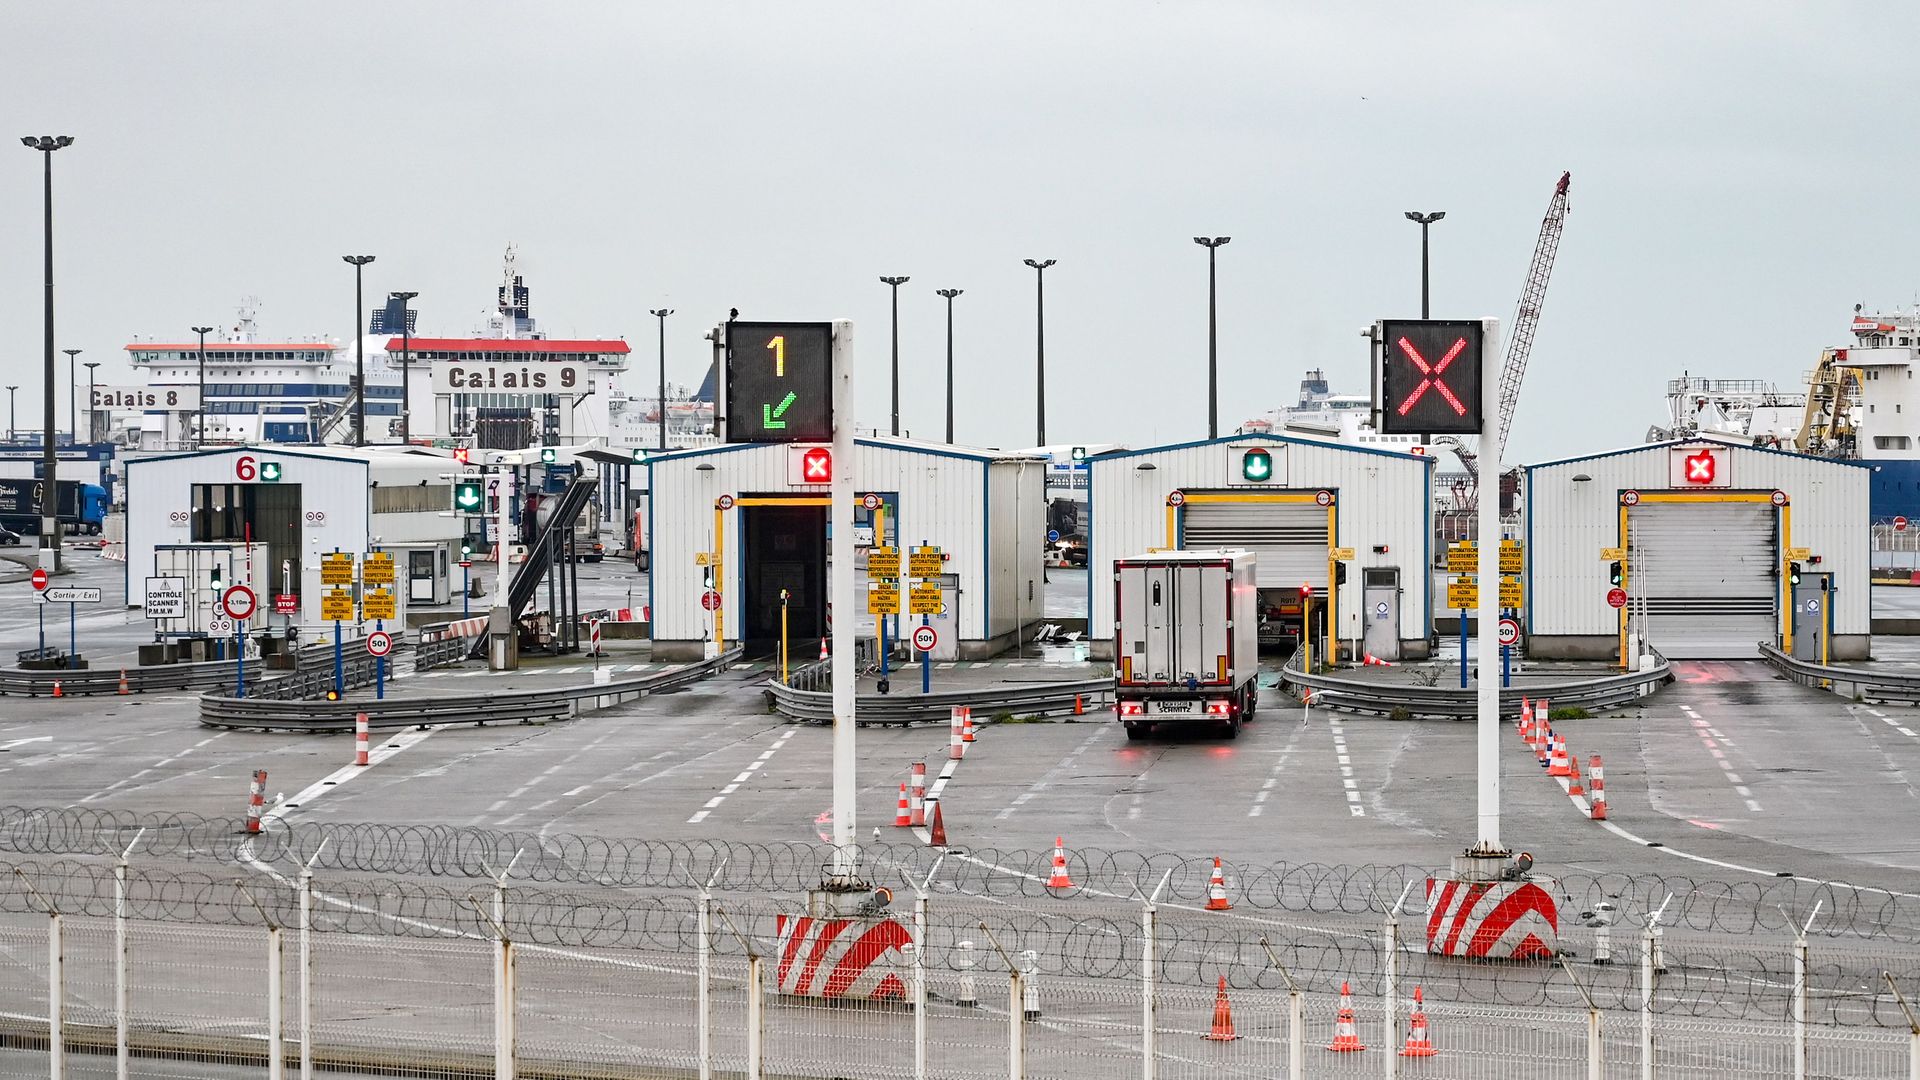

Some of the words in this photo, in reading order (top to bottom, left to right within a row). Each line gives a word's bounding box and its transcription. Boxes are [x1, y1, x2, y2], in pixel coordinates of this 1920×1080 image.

[767, 336, 784, 376] 1
[449, 368, 546, 388] Calais
[560, 368, 576, 388] 9
[90, 390, 156, 406] Calais
[166, 390, 178, 406] 8
[236, 456, 256, 480] 6
